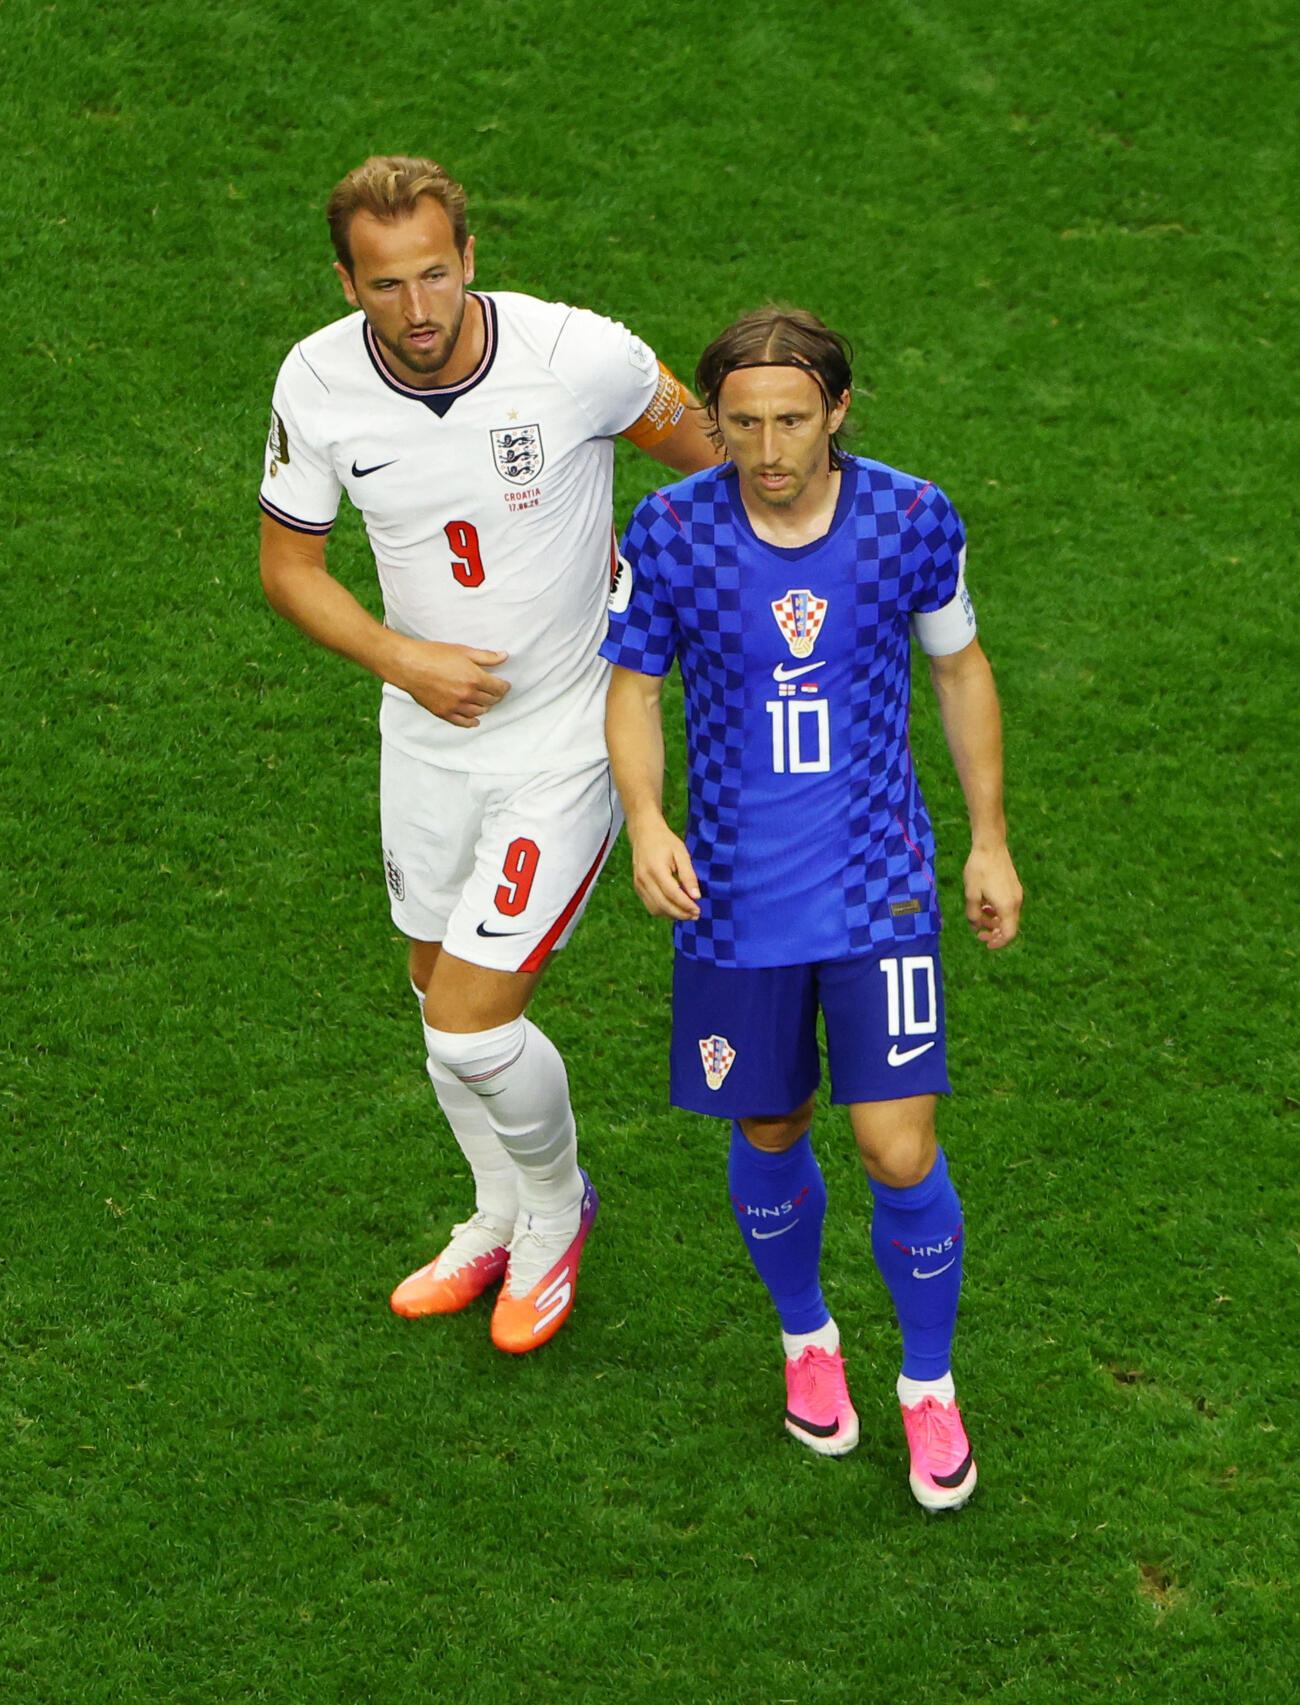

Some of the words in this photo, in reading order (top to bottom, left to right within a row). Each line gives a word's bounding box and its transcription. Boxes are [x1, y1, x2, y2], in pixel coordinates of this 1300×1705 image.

[504, 488, 541, 501] CROATIA
[444, 520, 486, 588] 9
[766, 699, 830, 773] 10
[494, 837, 540, 917] 9
[880, 956, 937, 1036] 10
[747, 1200, 793, 1217] HNS
[912, 1236, 953, 1256] HNS
